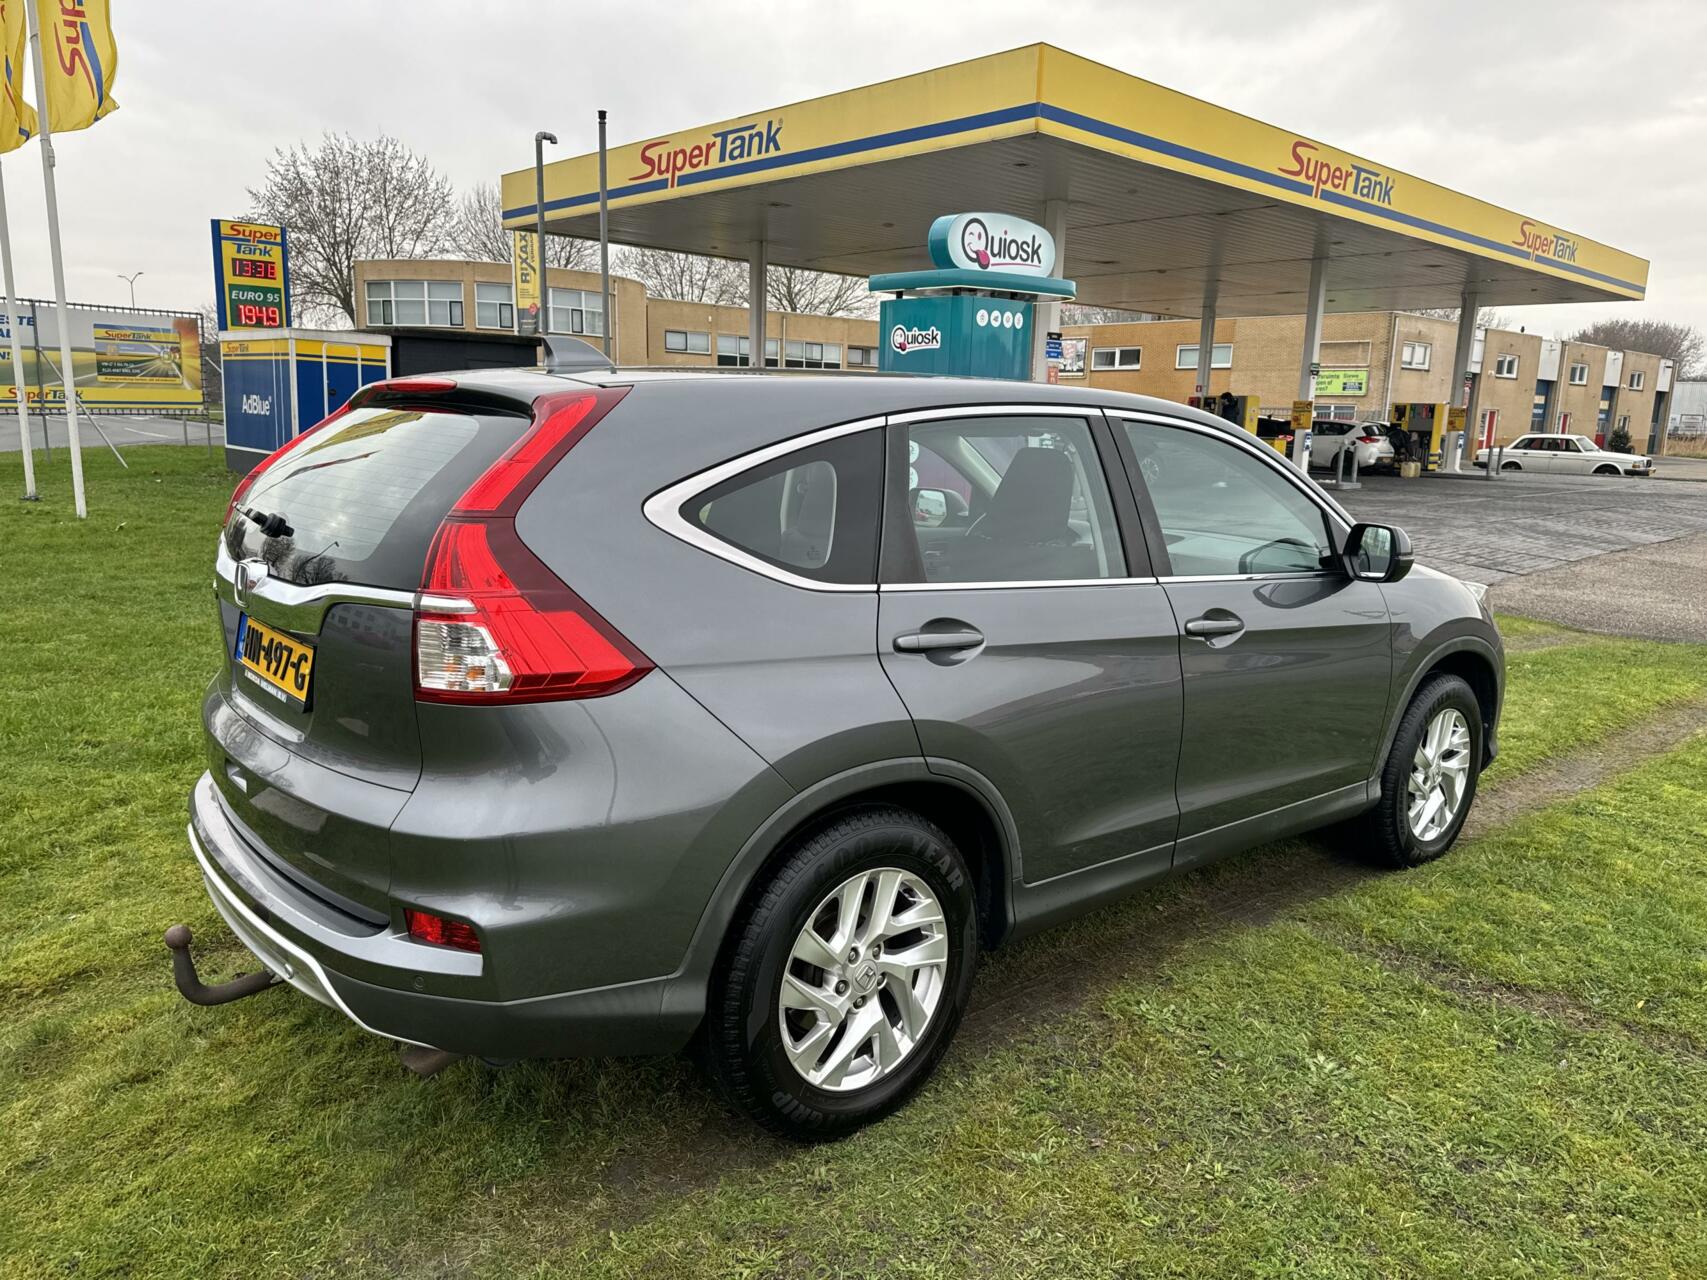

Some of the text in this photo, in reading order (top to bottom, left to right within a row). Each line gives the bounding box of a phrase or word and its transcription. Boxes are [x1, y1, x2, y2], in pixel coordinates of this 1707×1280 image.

[628, 119, 783, 188] SuperTank
[1277, 140, 1395, 206] SuperTank
[221, 223, 281, 244] Super
[231, 242, 273, 258] Tank
[961, 217, 1042, 270] Quiosk
[1511, 219, 1579, 263] SuperTank
[231, 290, 281, 303] EURO 95
[892, 327, 939, 351] Quiosk
[2, 387, 83, 403] SperTak
[244, 624, 308, 691] HN-497-G
